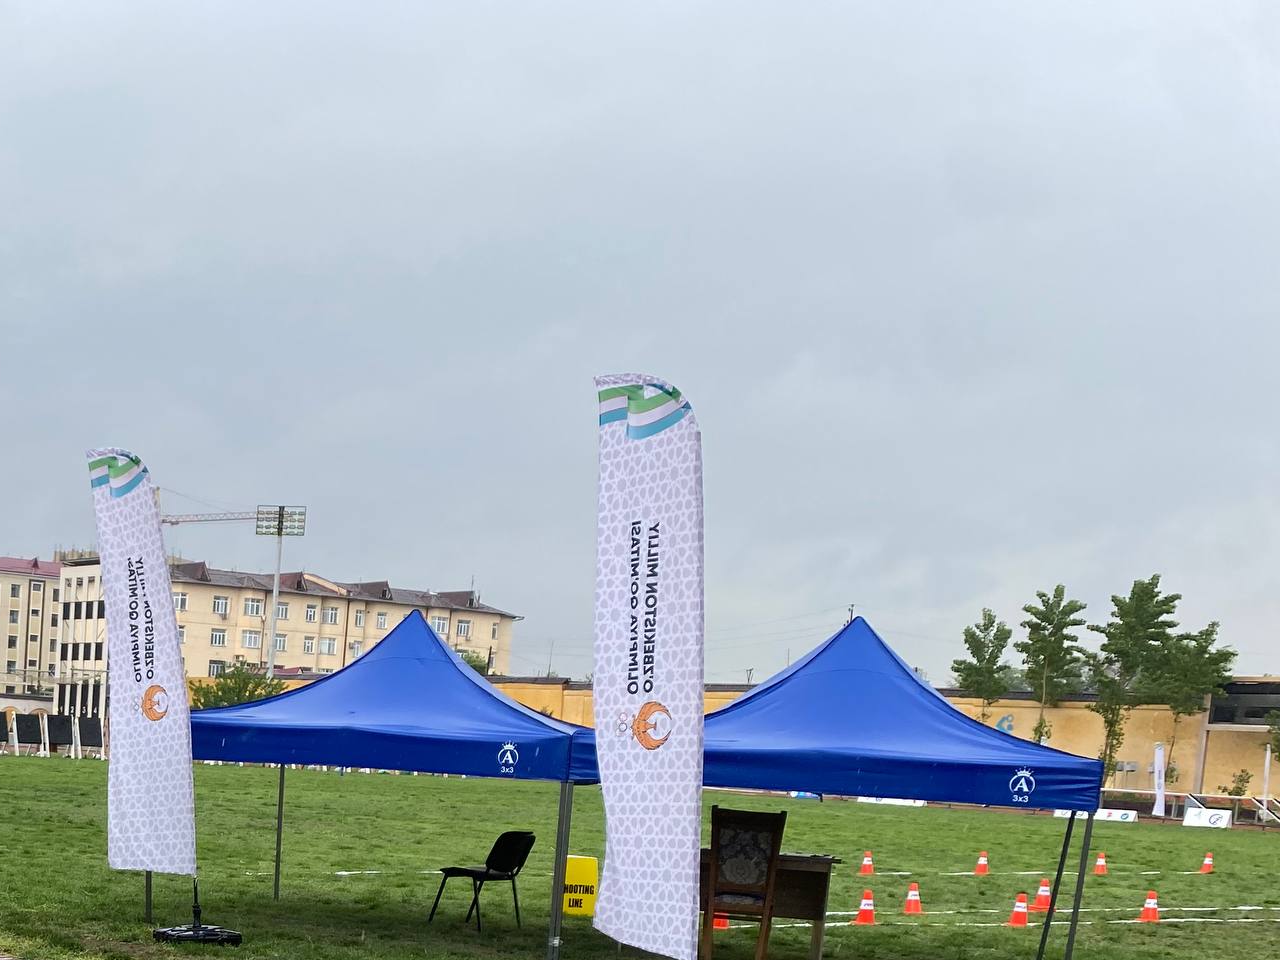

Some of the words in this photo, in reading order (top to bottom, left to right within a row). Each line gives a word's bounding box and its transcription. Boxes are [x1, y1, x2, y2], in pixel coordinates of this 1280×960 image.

[501, 750, 514, 764] A
[1013, 777, 1029, 792] A
[564, 884, 595, 895] HOOTING
[568, 898, 583, 908] LINE
